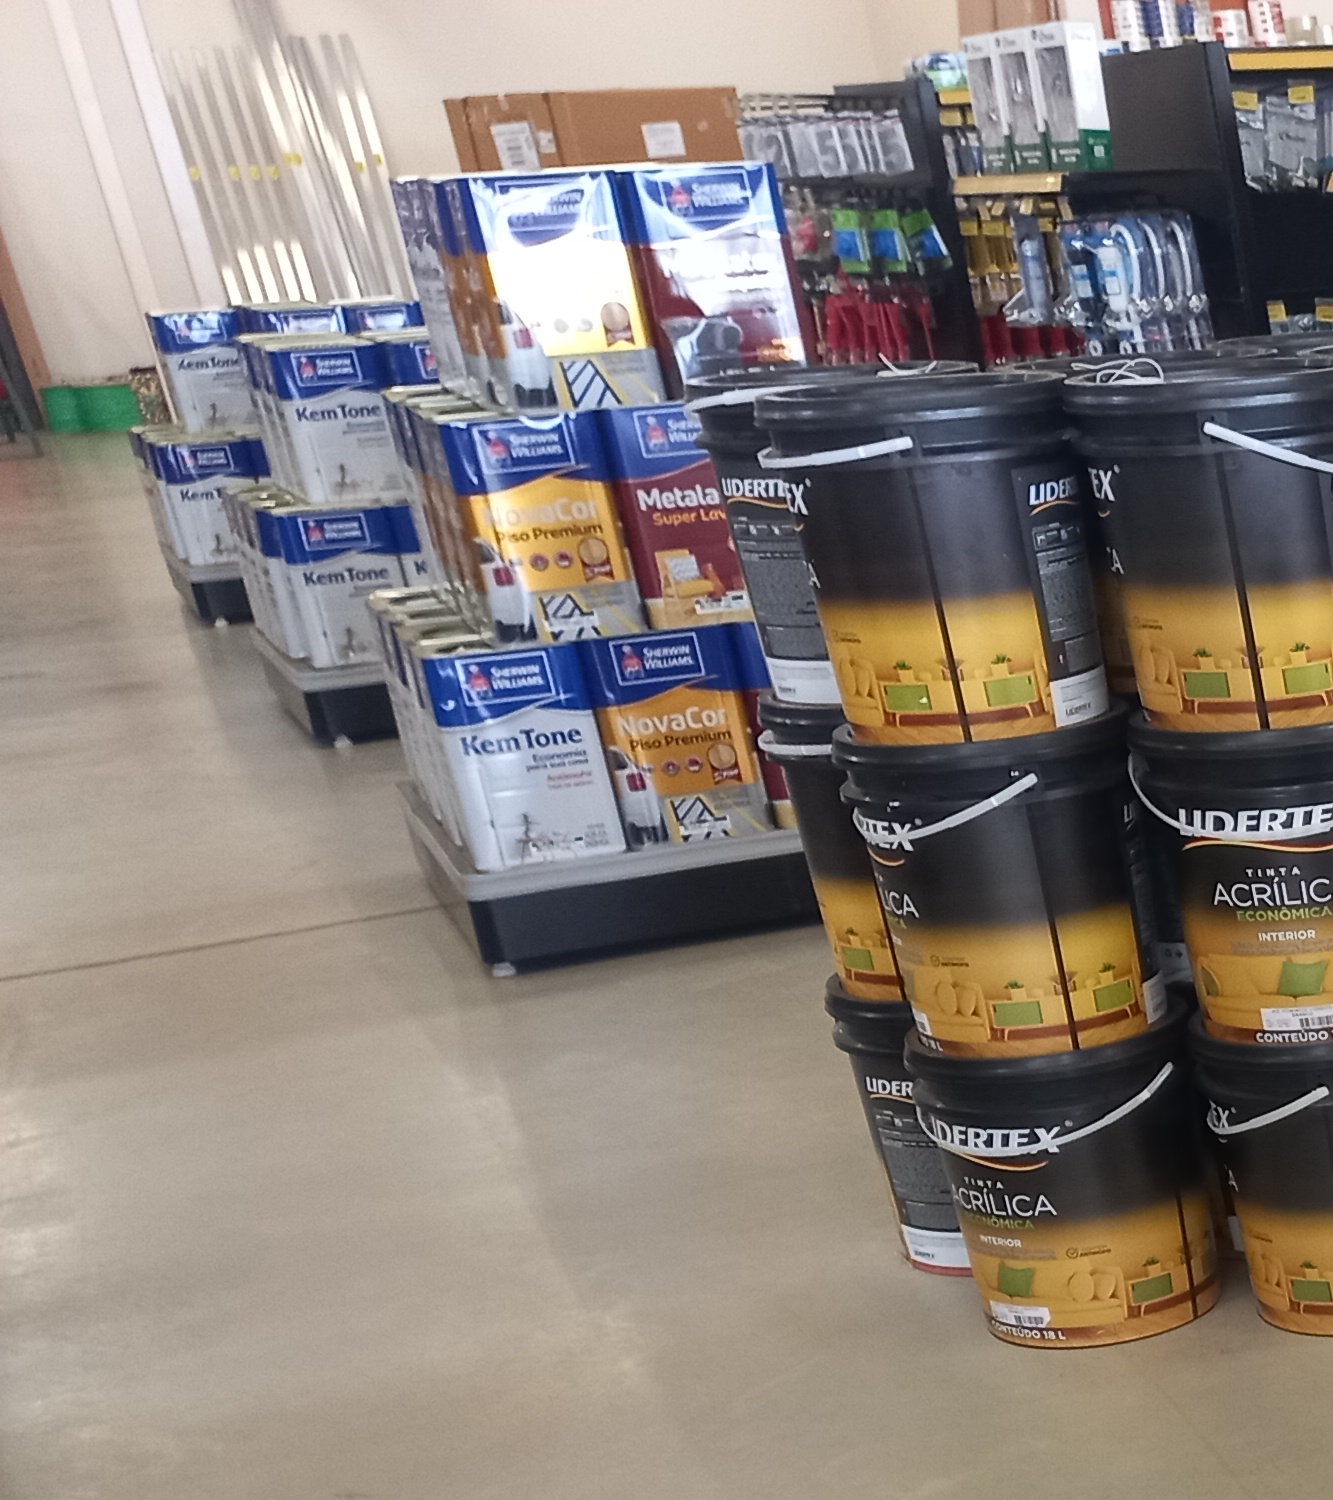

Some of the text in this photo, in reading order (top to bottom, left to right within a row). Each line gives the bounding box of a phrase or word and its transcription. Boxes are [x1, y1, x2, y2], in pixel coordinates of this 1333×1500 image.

[295, 404, 382, 422] KemTone
[652, 510, 695, 527] Super
[532, 522, 603, 541] Premium
[303, 566, 389, 587] KemTone
[643, 644, 691, 659] SHERWIN
[616, 705, 728, 737] NovaCor
[460, 728, 583, 757] KemTone
[629, 729, 732, 752] Piso Premium
[1245, 866, 1301, 878] TINTA
[1236, 905, 1333, 922] ECONÔMICA
[1258, 929, 1316, 942] INTERIOR
[1255, 1027, 1328, 1044] CONTEÚDO
[963, 1176, 1004, 1189] TINTA
[979, 1234, 1022, 1248] INTERIOR
[1042, 1329, 1056, 1340] 18
[1057, 1330, 1066, 1340] L
